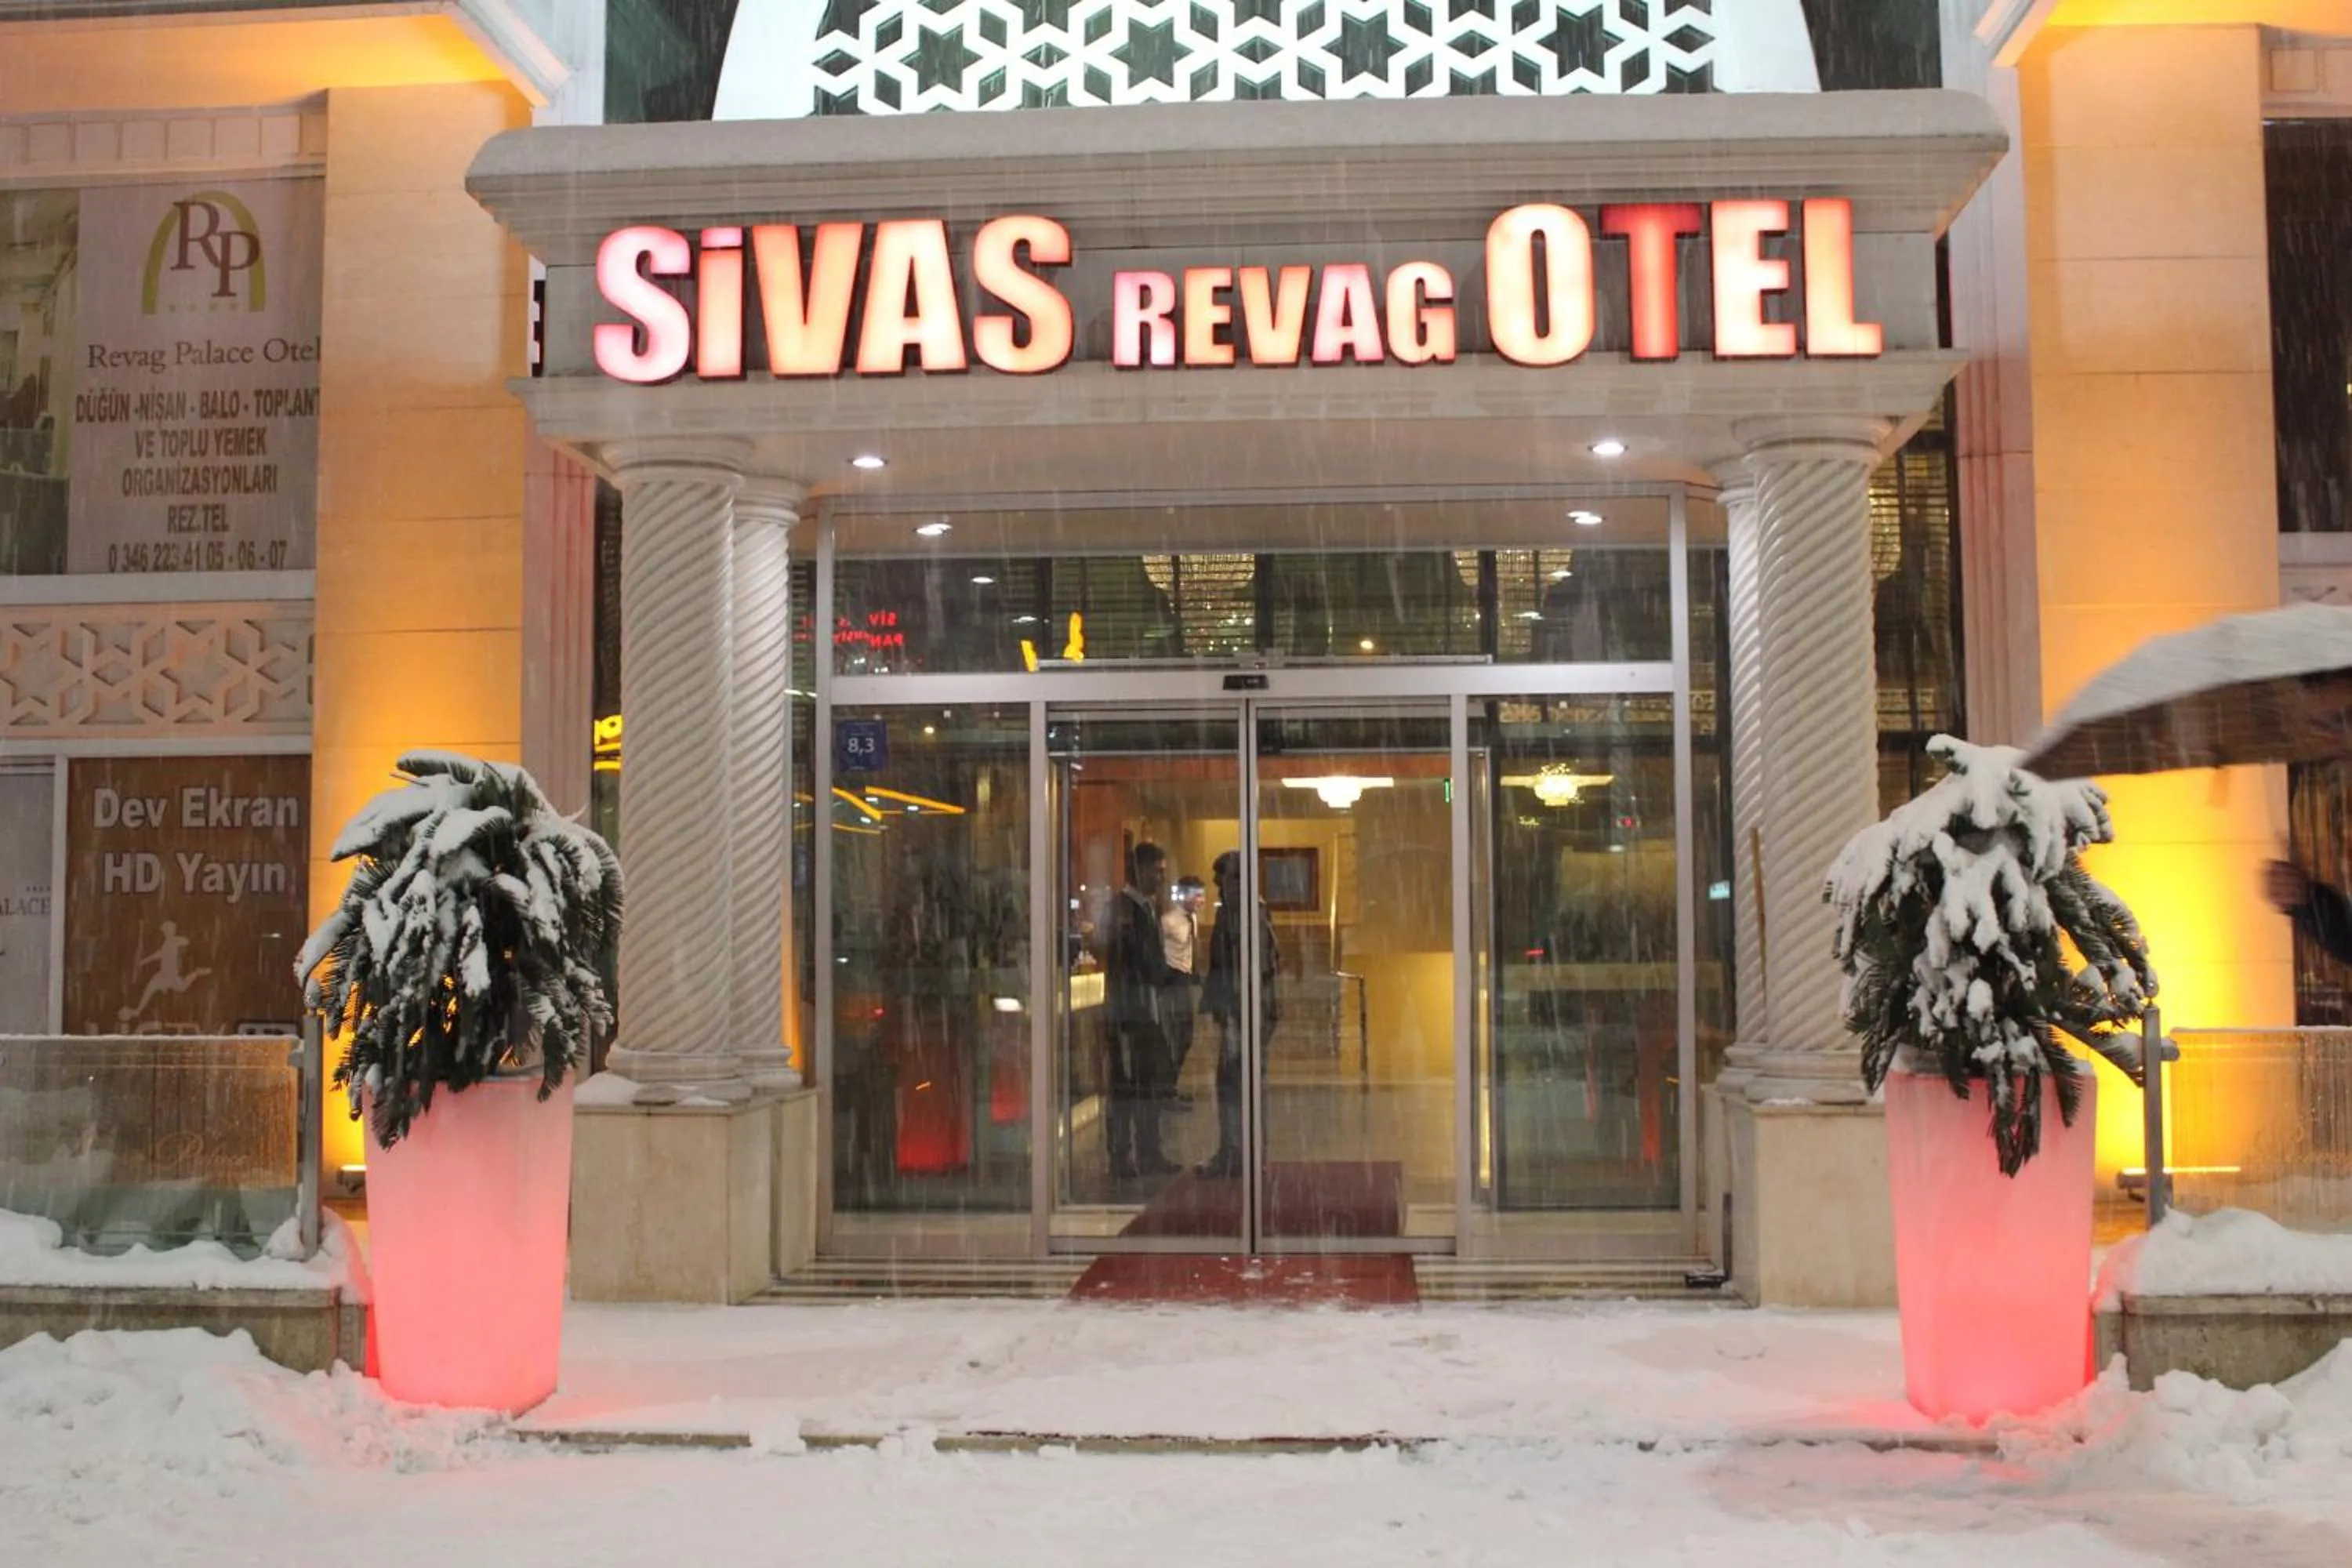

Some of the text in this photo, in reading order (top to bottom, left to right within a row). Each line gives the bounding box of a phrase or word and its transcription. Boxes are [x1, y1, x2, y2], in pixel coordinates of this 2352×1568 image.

[1113, 260, 1457, 367] REVAG
[1486, 197, 1883, 367] OTEL
[86, 336, 321, 375] Revag Palace Otel
[199, 390, 241, 420] BALO
[135, 426, 267, 459] VE TOPLU YEMEK
[848, 737, 875, 757] 8,3
[93, 787, 299, 828] Dev Ekran
[103, 852, 285, 903] HD Yayın
